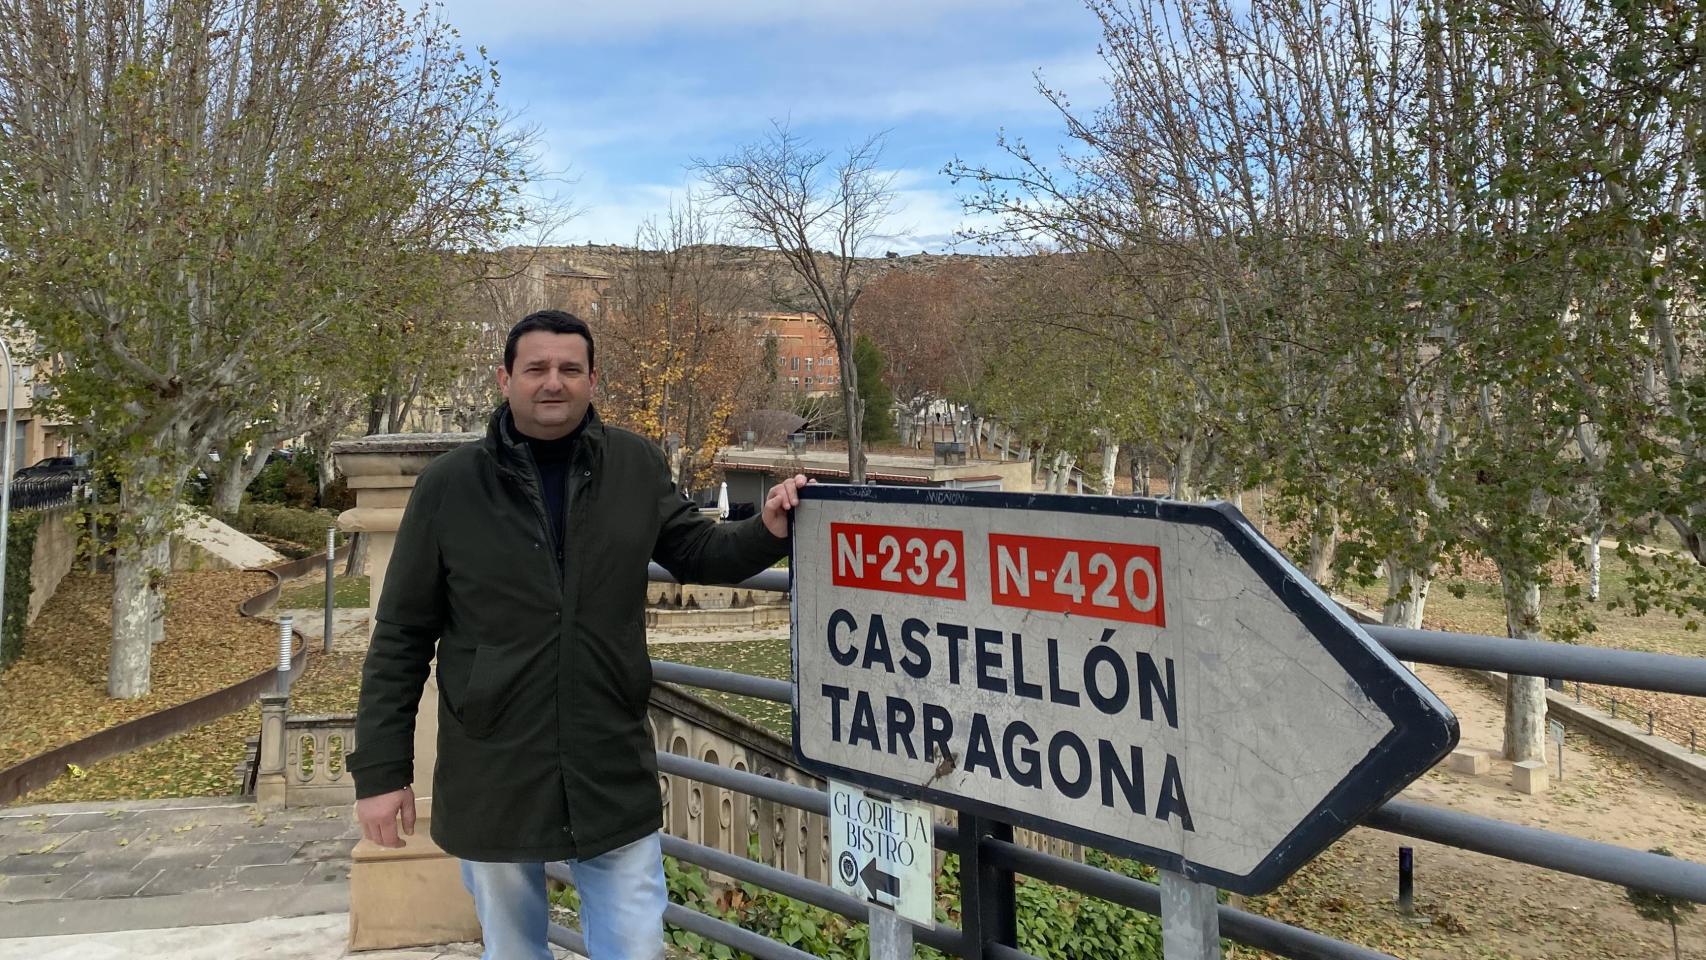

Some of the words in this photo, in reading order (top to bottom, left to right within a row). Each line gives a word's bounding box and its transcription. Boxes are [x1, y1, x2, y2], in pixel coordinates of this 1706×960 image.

[837, 533, 958, 589] N-232
[997, 545, 1157, 612] N-420
[827, 608, 1179, 729] CASTELLÓN
[822, 684, 1195, 832] TARRAGONA
[834, 791, 928, 843] GLORIETA
